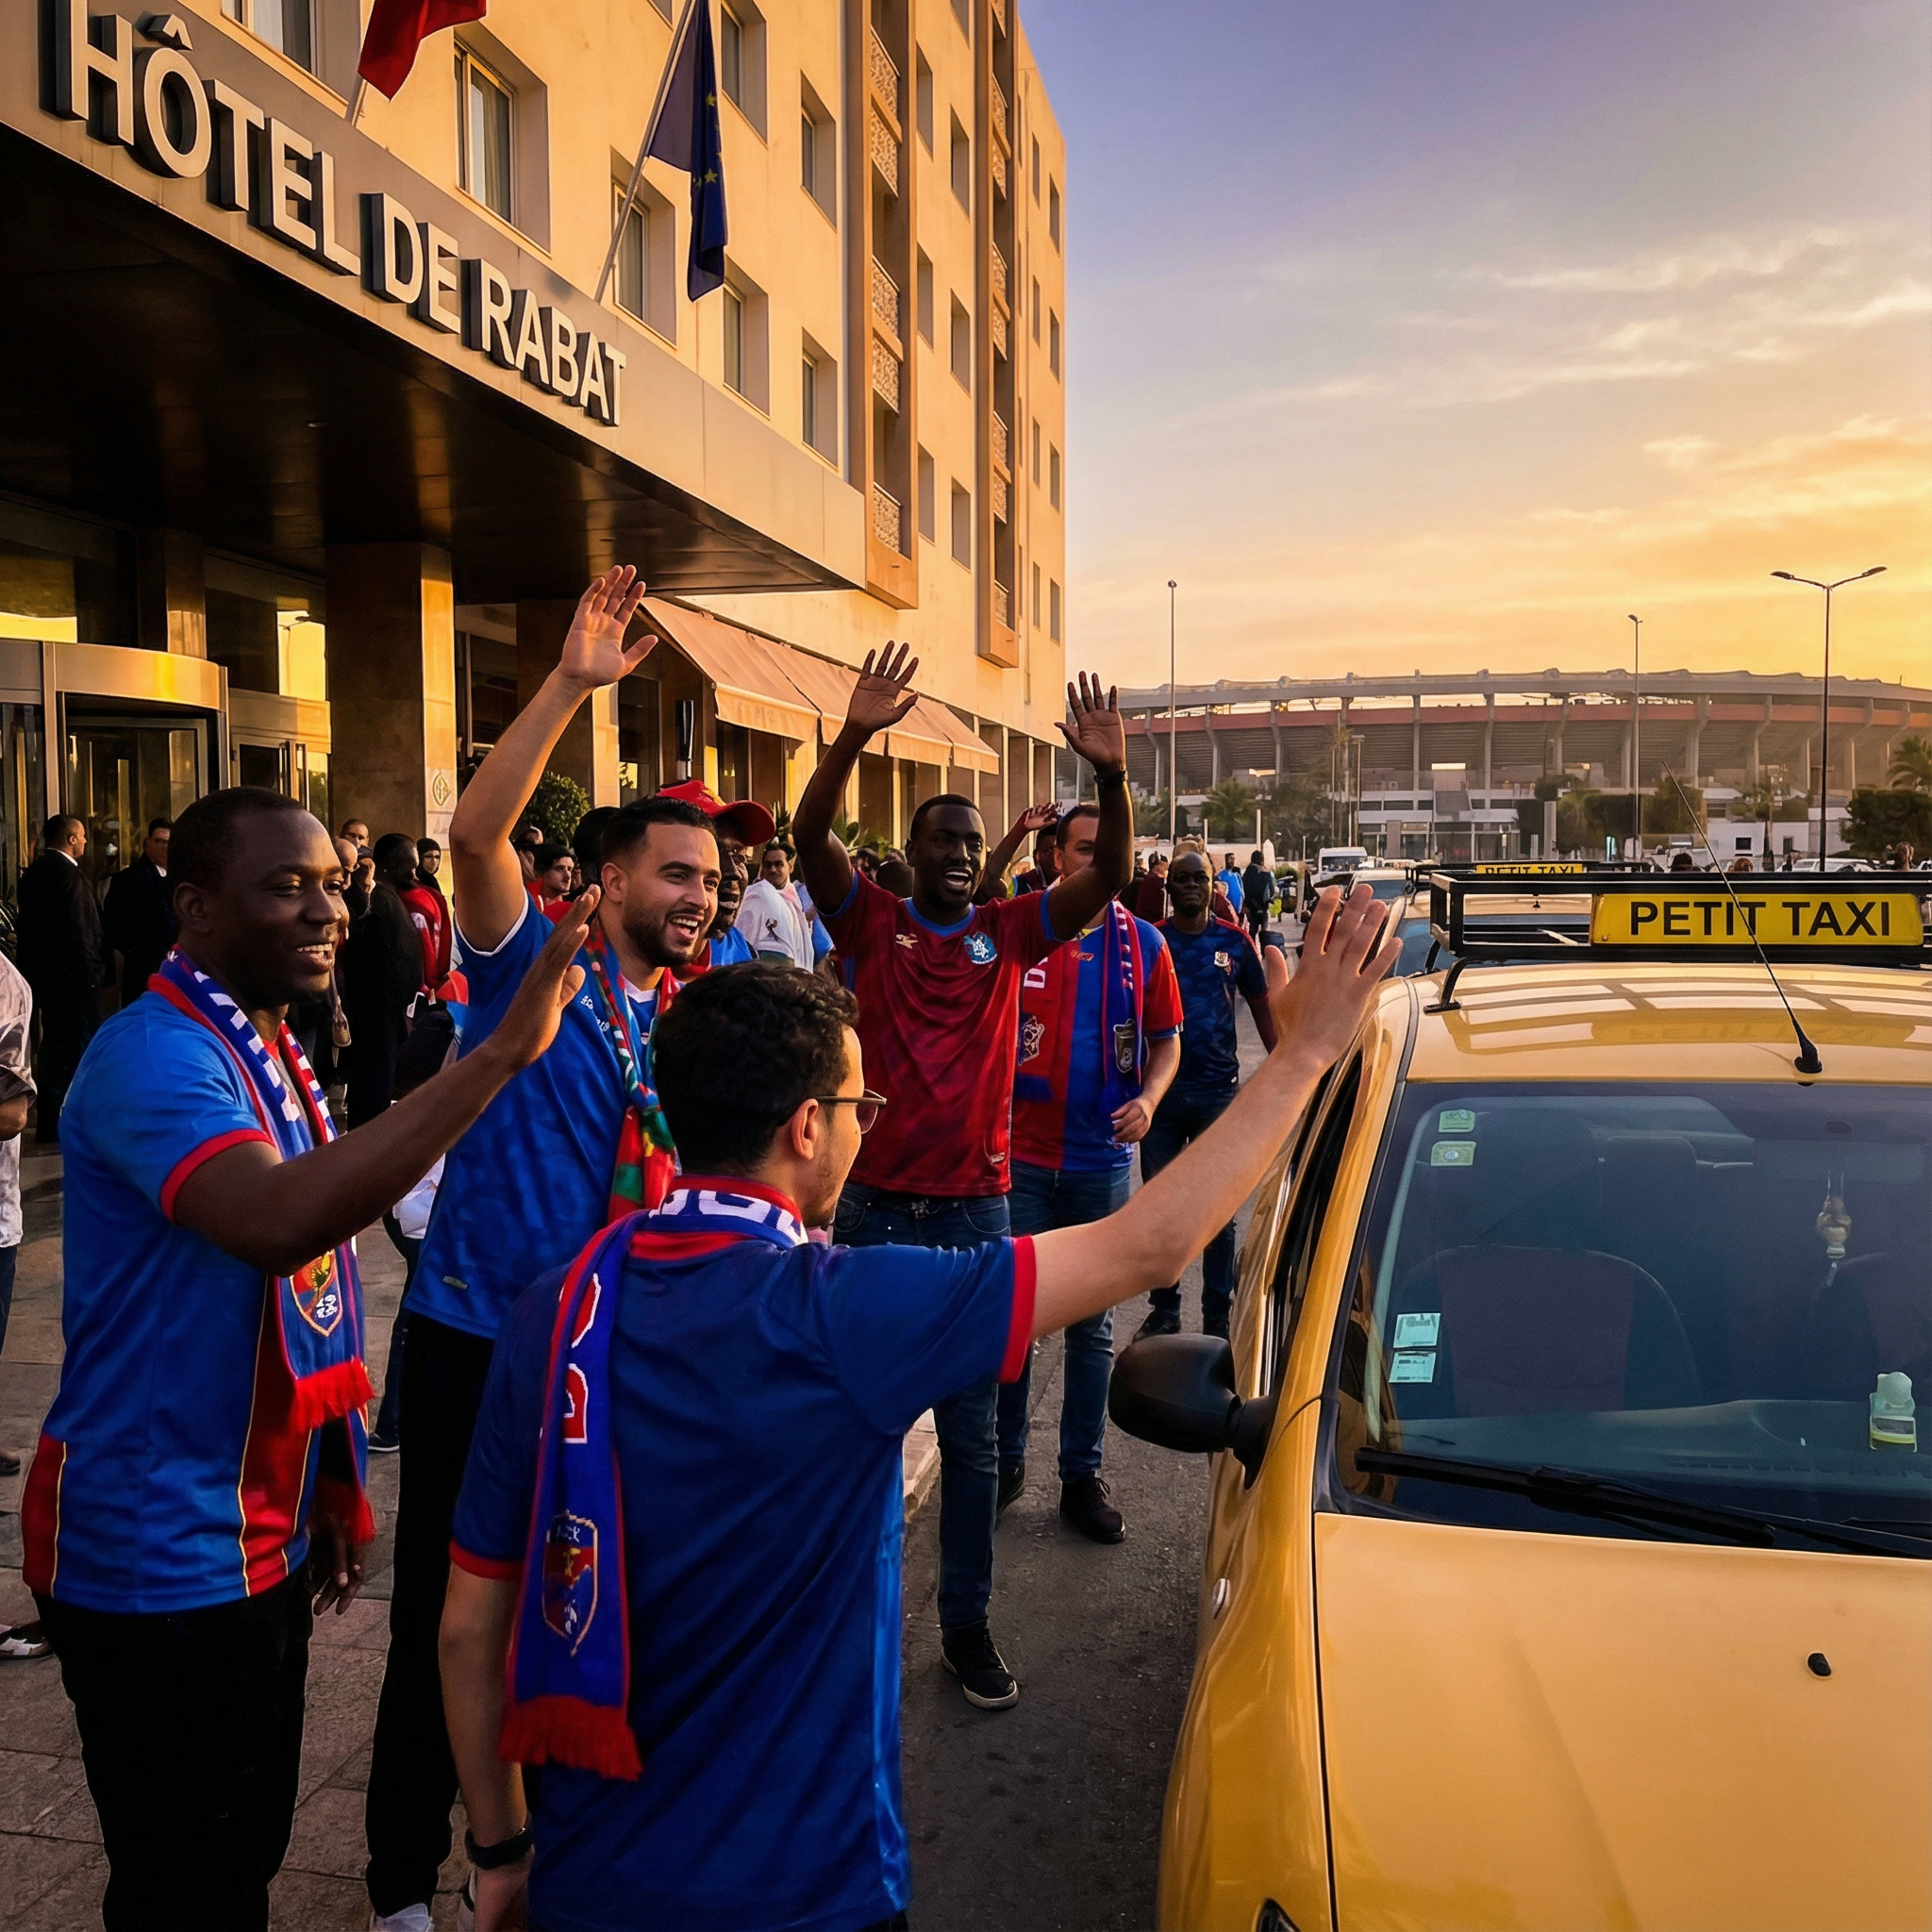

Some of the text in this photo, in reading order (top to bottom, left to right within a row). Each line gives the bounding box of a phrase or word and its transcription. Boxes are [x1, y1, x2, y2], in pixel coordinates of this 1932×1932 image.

[58, 0, 626, 426] HÔTEL DE RABAT
[1629, 901, 1890, 936] PETIT TAXI
